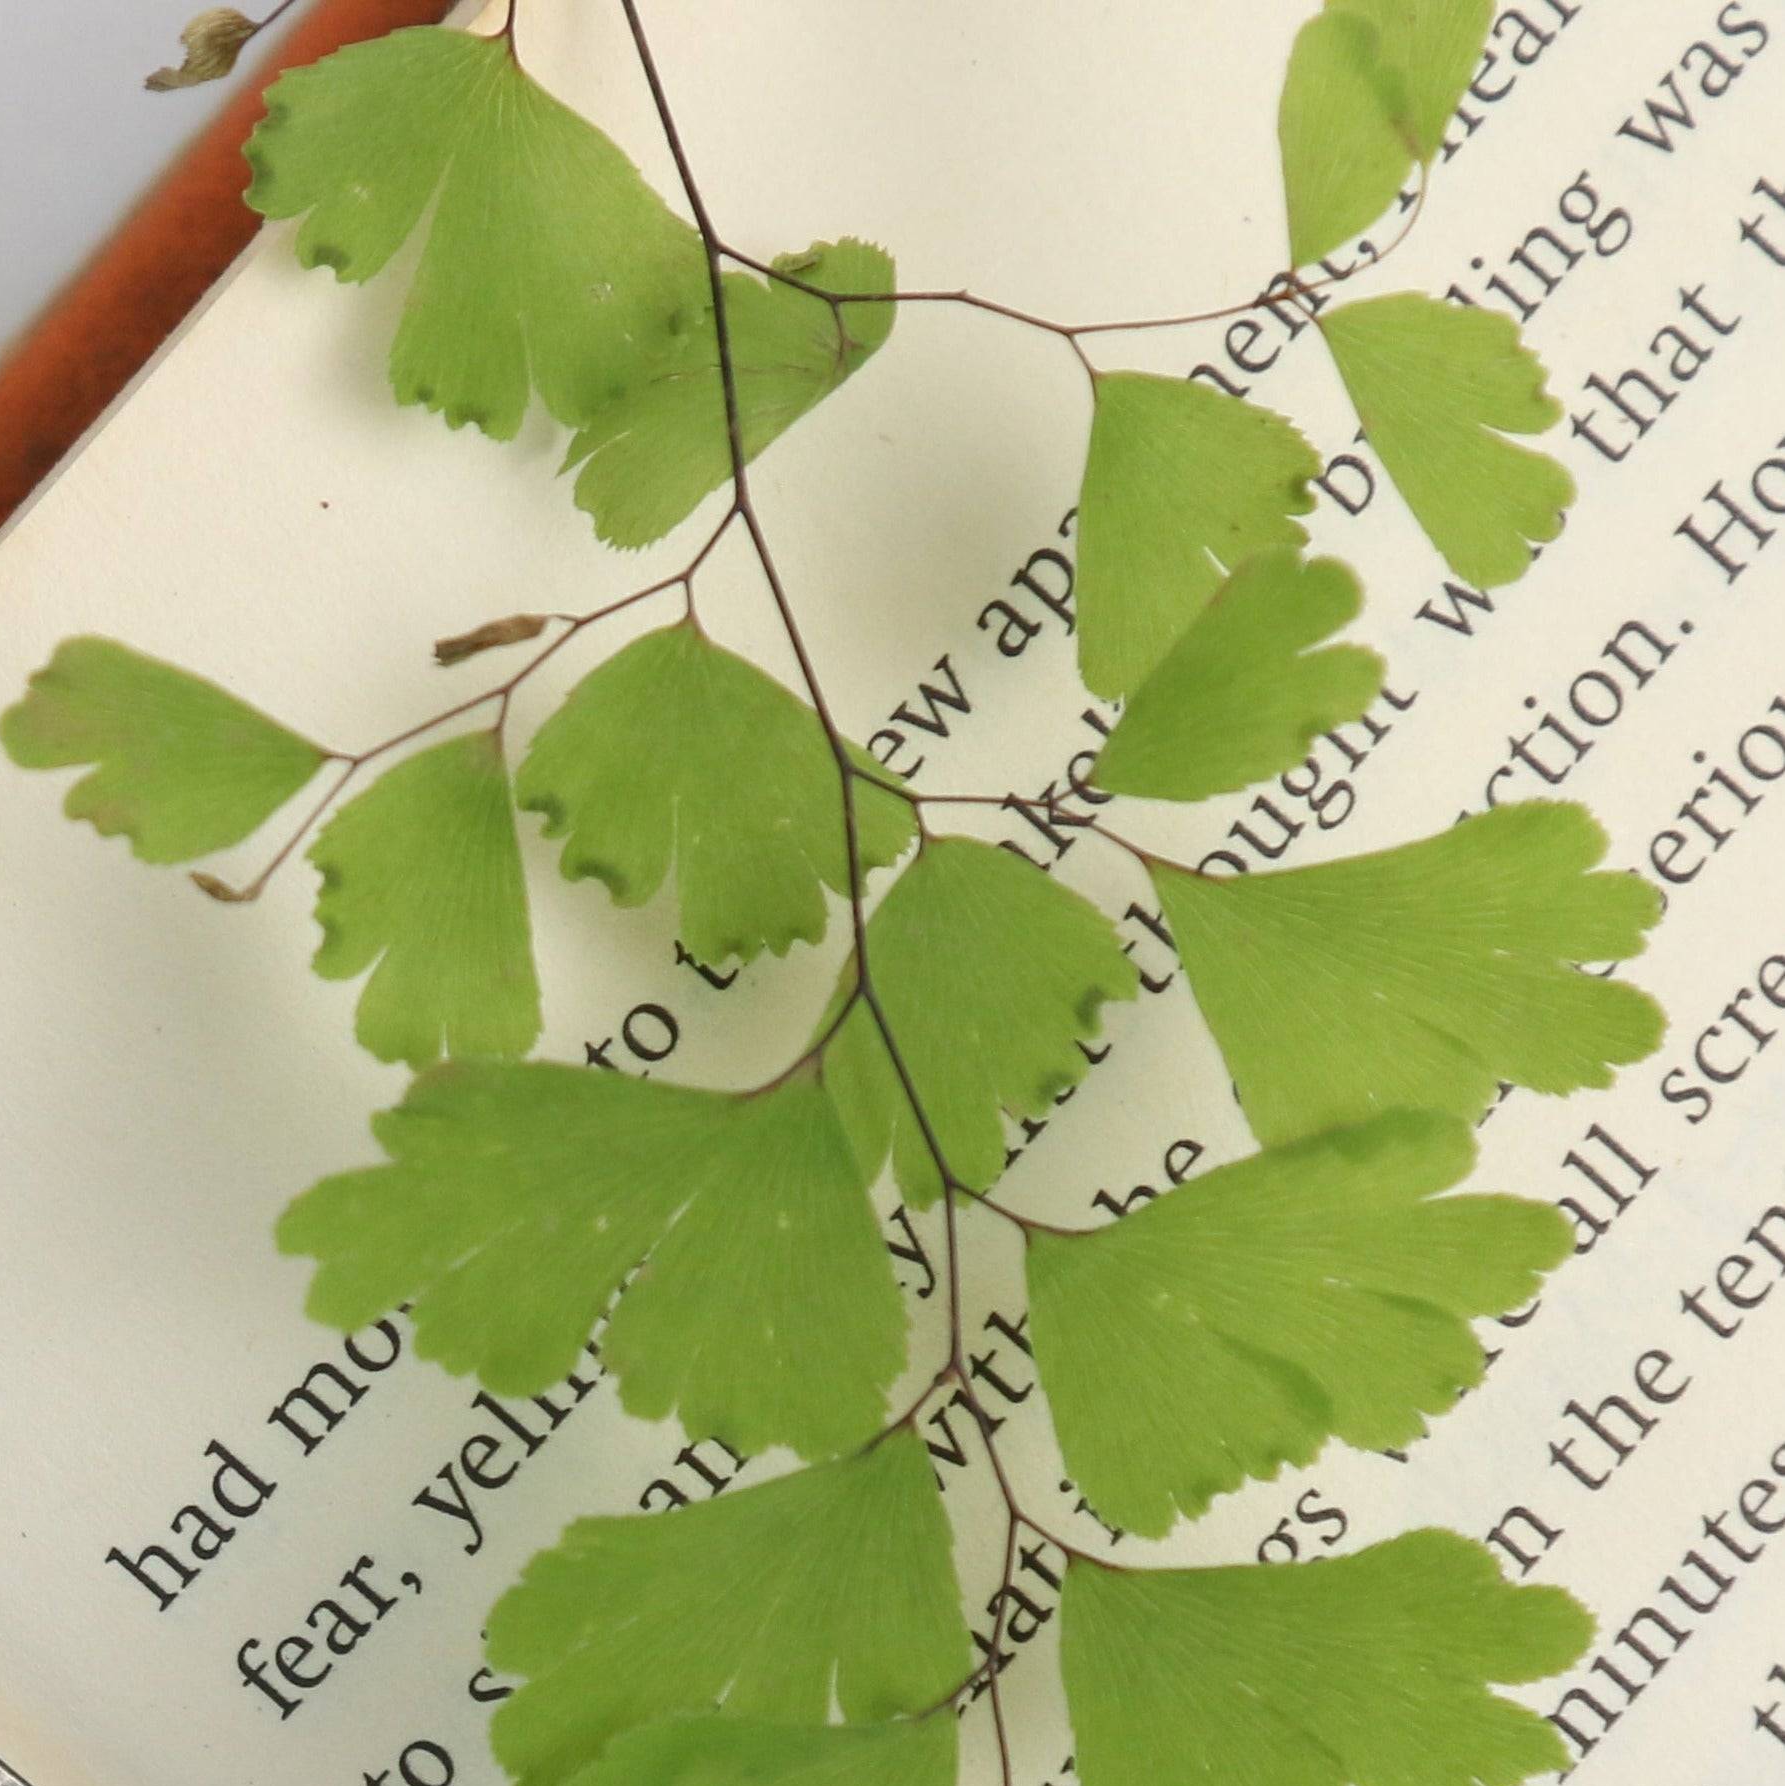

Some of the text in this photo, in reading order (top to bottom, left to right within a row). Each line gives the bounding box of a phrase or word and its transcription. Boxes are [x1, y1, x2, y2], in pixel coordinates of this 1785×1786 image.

[1570, 285, 1740, 462] that
[1674, 437, 1785, 585] Ho
[236, 1554, 423, 1721] fear,
[1616, 2, 1768, 153] was
[104, 1438, 278, 1613] had
[867, 653, 972, 780] ew
[1556, 1123, 1659, 1255] all
[1549, 1349, 1690, 1491] the
